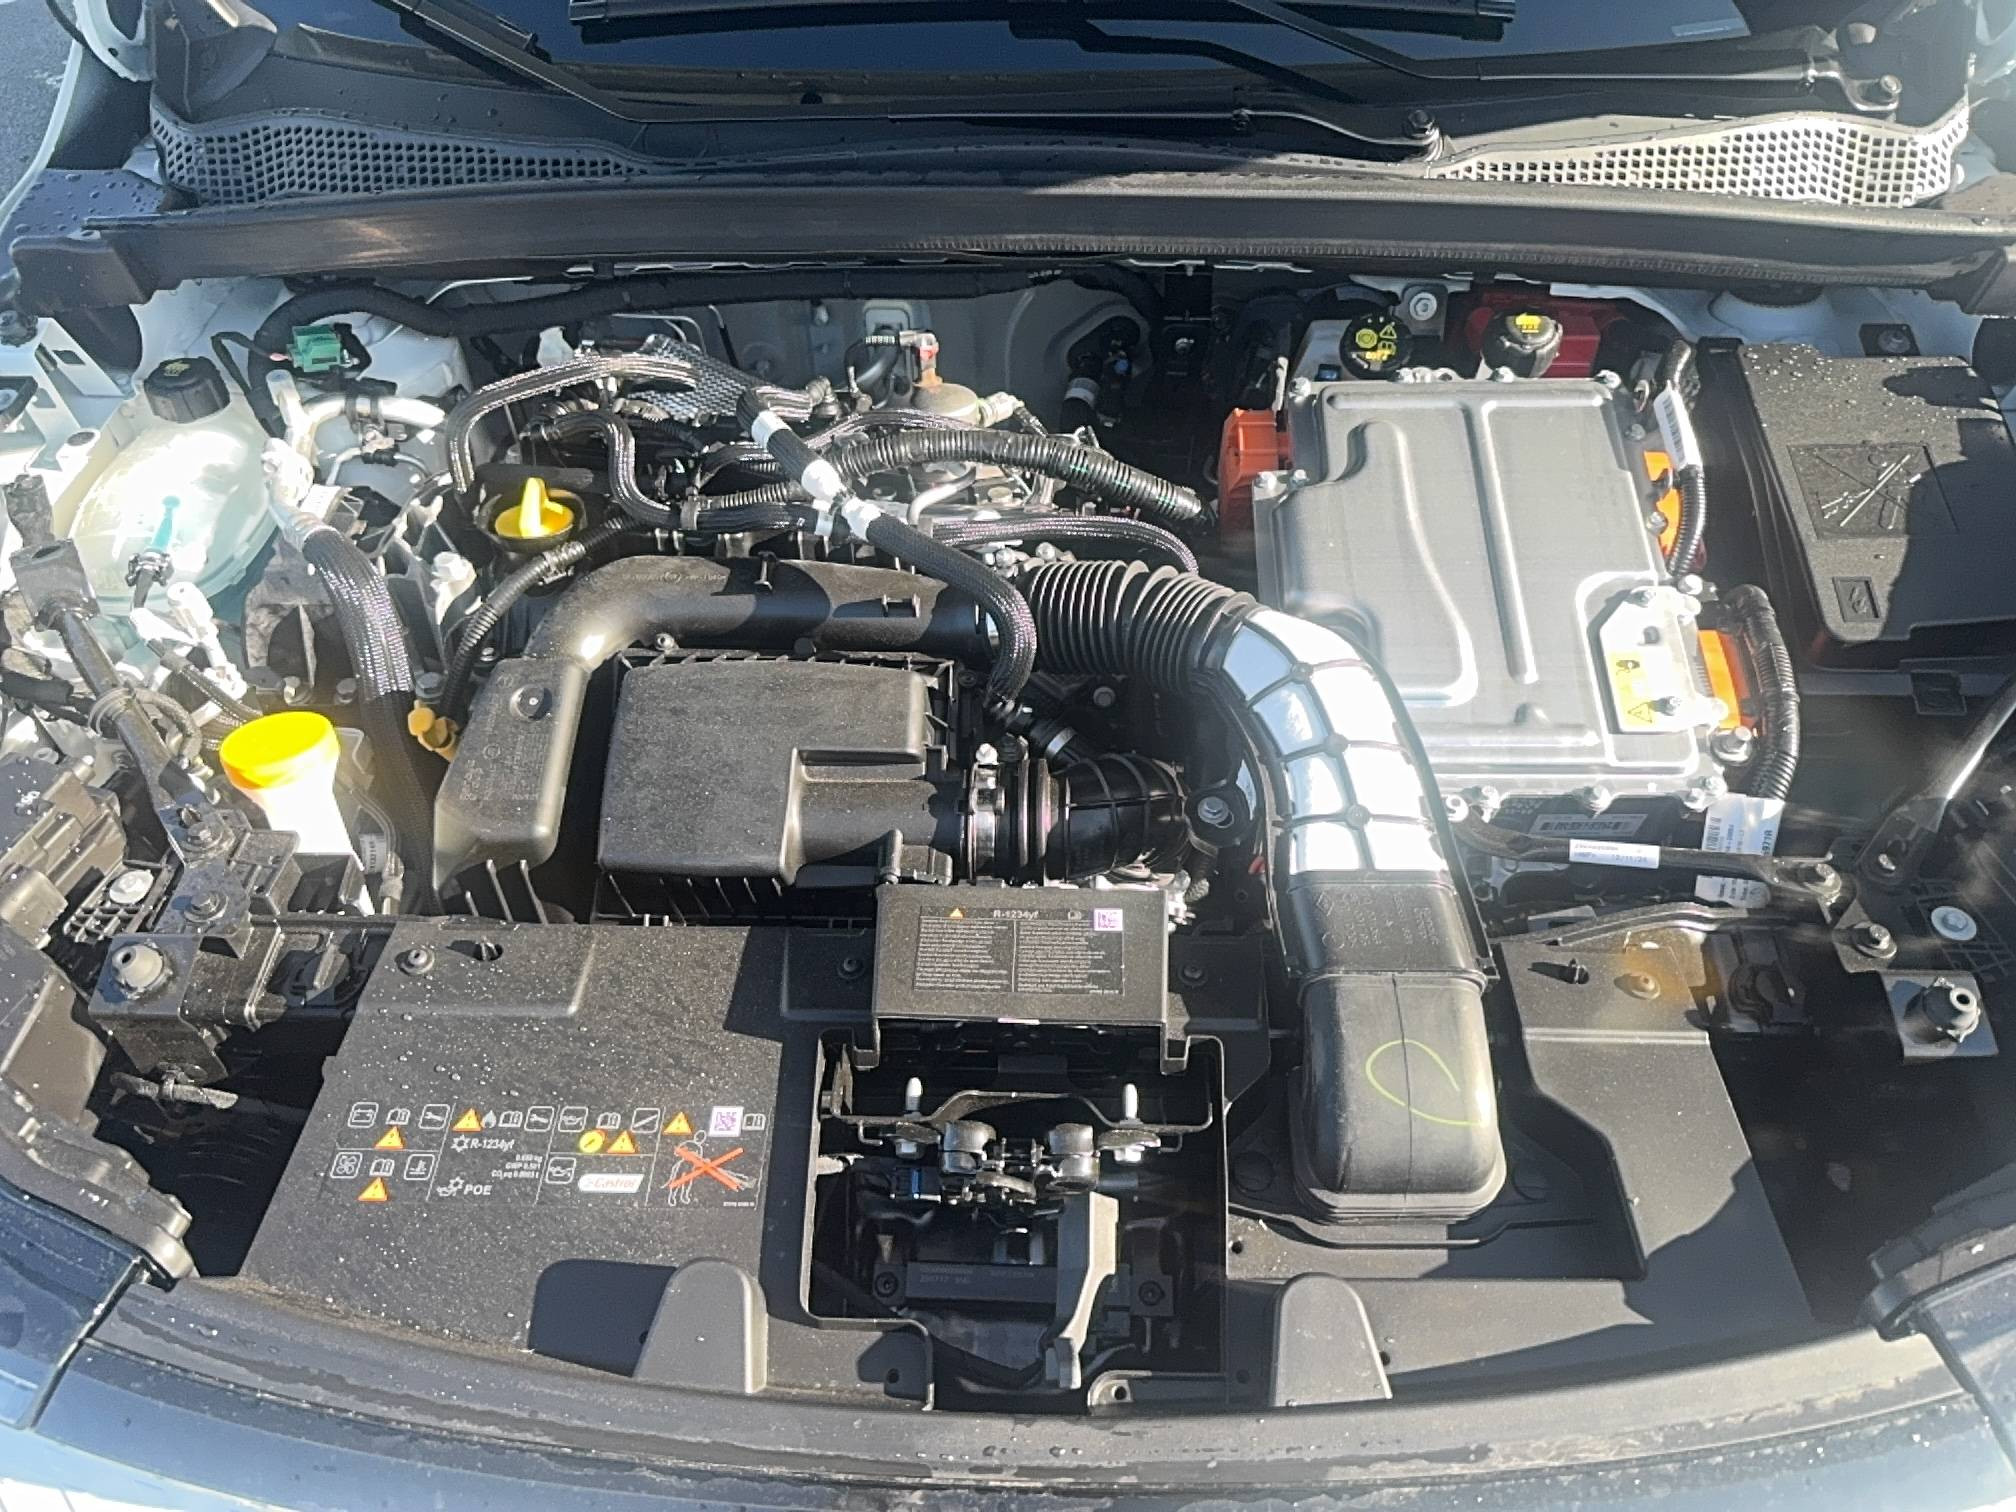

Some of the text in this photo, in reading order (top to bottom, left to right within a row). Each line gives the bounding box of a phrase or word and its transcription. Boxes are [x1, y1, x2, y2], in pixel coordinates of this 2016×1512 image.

[993, 909, 1039, 920] R-1234yf
[470, 1138, 515, 1153] R-1234yf
[593, 1178, 637, 1189] Castrol
[463, 1184, 493, 1195] POE
